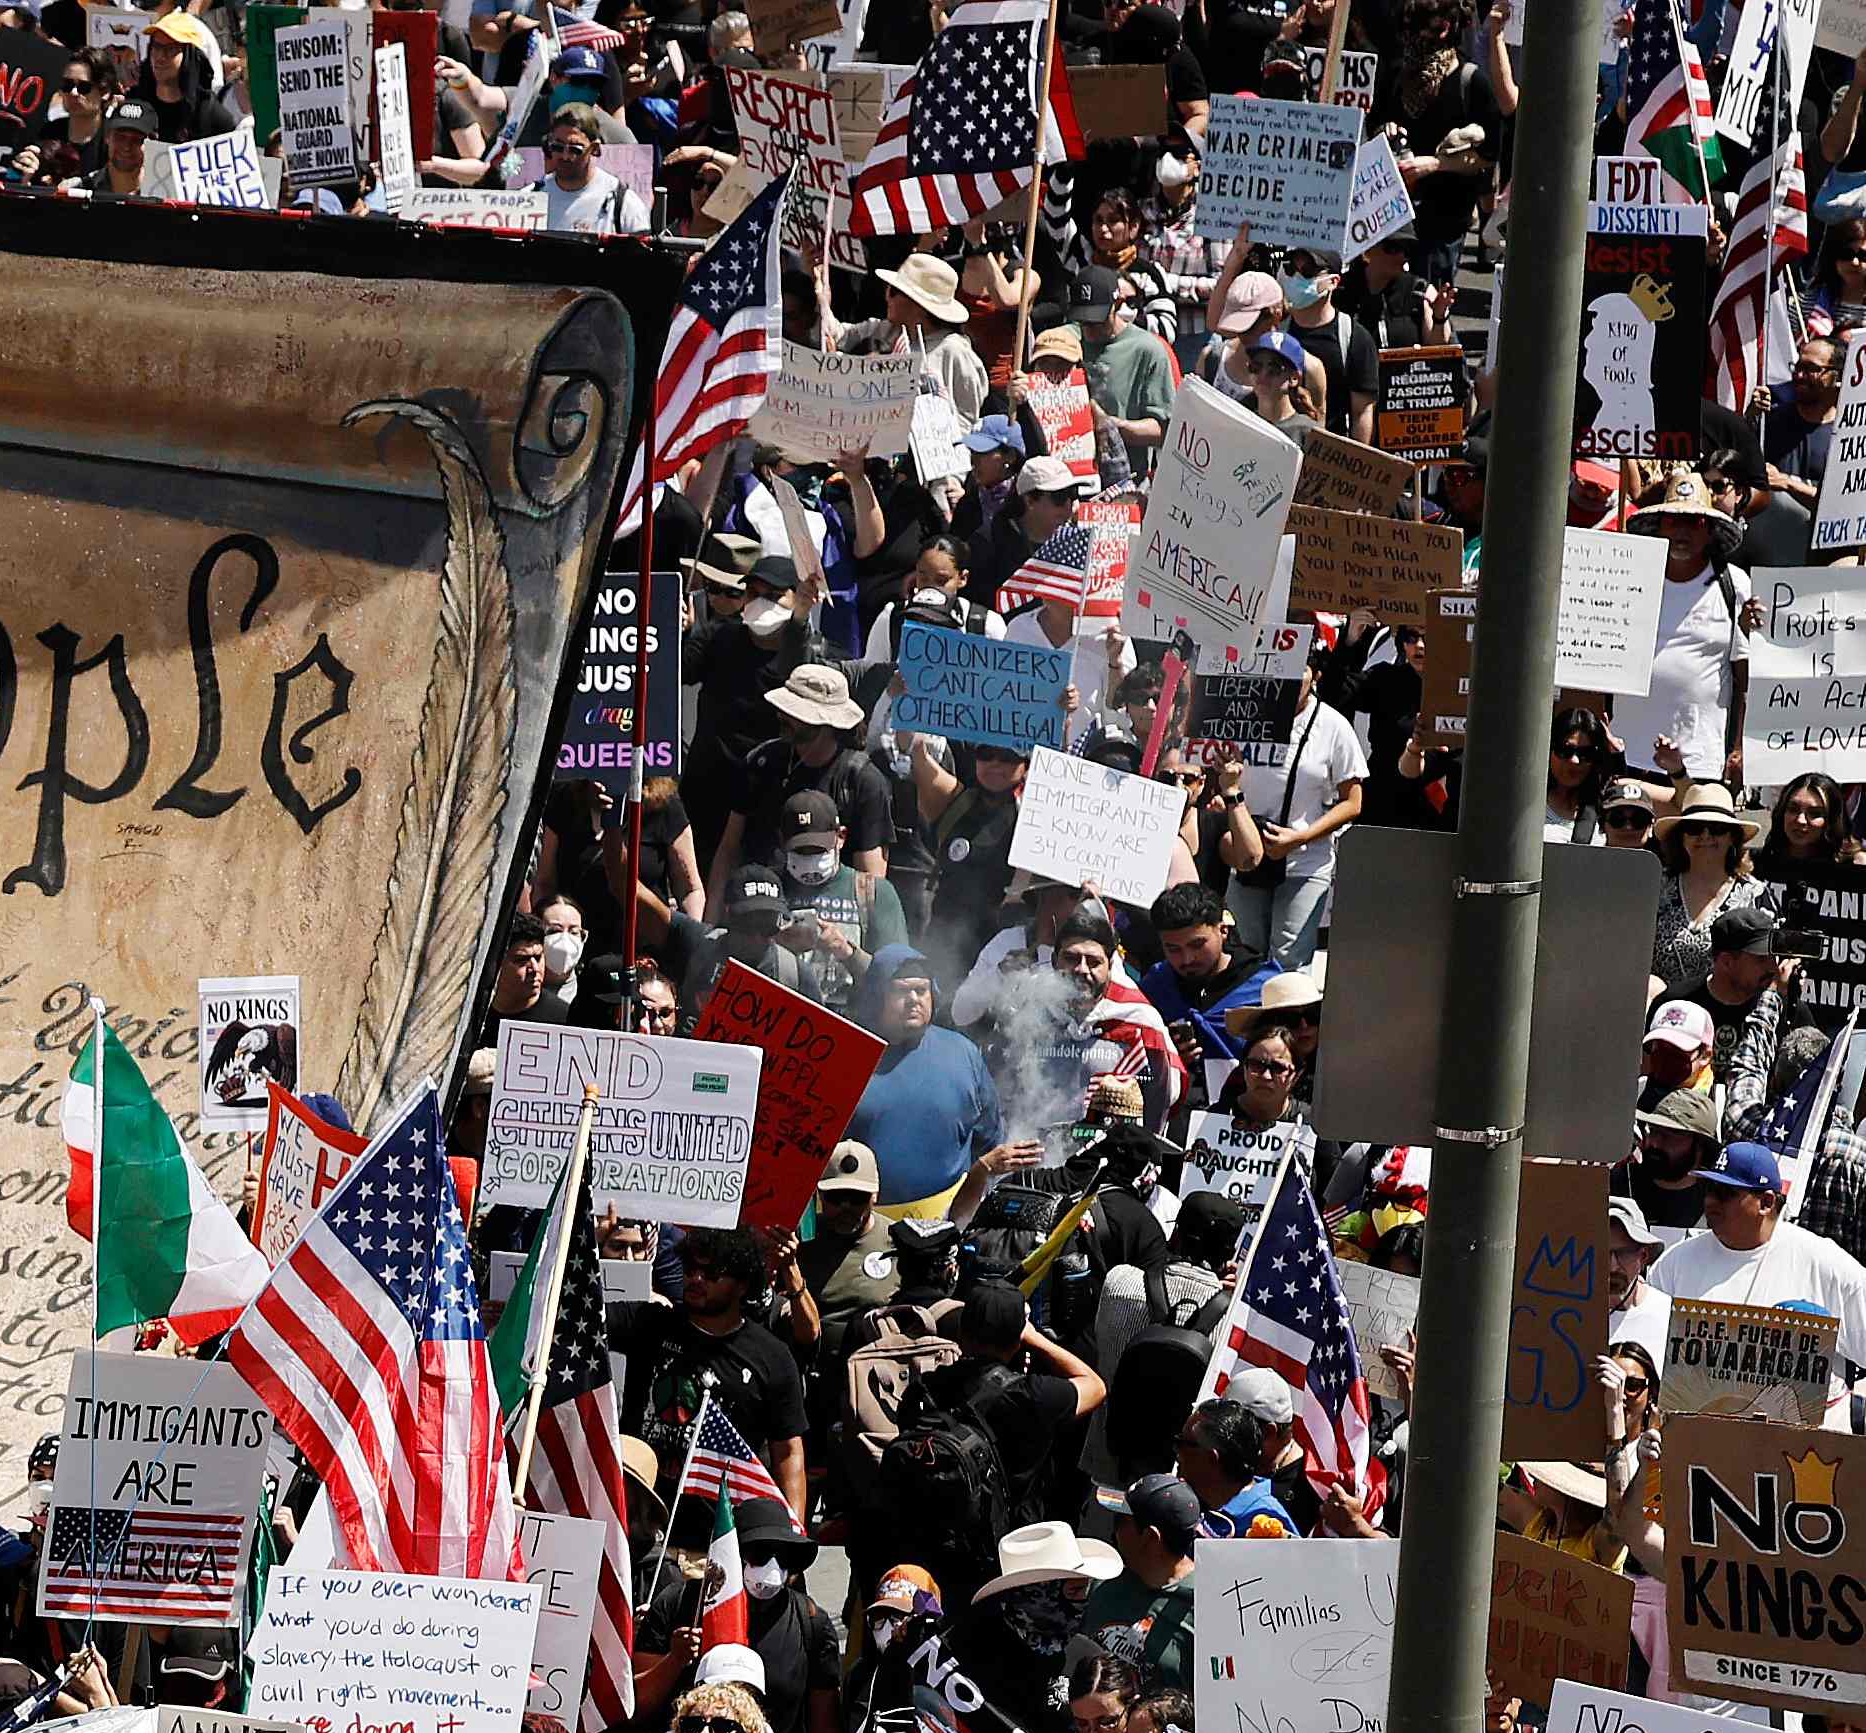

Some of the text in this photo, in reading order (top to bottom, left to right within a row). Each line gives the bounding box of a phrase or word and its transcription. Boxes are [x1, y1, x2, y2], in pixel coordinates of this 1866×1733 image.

[276, 37, 343, 62] NEWSOM:
[282, 107, 345, 130] NATIONAL
[726, 65, 837, 147] RESPECT
[178, 135, 252, 177] FUCK
[1206, 128, 1330, 167] WAR CRIME
[1200, 177, 1286, 205] DECIDE
[1176, 428, 1213, 470] NO
[1145, 528, 1263, 626] AMERICA!!
[905, 625, 1062, 681] COLONIZERS
[979, 704, 1062, 747] ILLEGAL
[206, 1001, 290, 1024] NO KINGS
[501, 1026, 664, 1102] END
[1217, 1127, 1284, 1153] PROUD
[1738, 1322, 1790, 1349] FUERA
[1667, 1335, 1830, 1387] TOVAANGAR
[70, 1397, 270, 1449] IMMIGANTS
[113, 1461, 195, 1508] ARE
[56, 1536, 221, 1587] AMERICA
[277, 1573, 310, 1600] If
[320, 1578, 362, 1609] you
[371, 1579, 425, 1602] ever
[1220, 1575, 1343, 1638] Familias
[1680, 1554, 1866, 1645] KINGS
[1714, 1656, 1840, 1694] SINCE 1776
